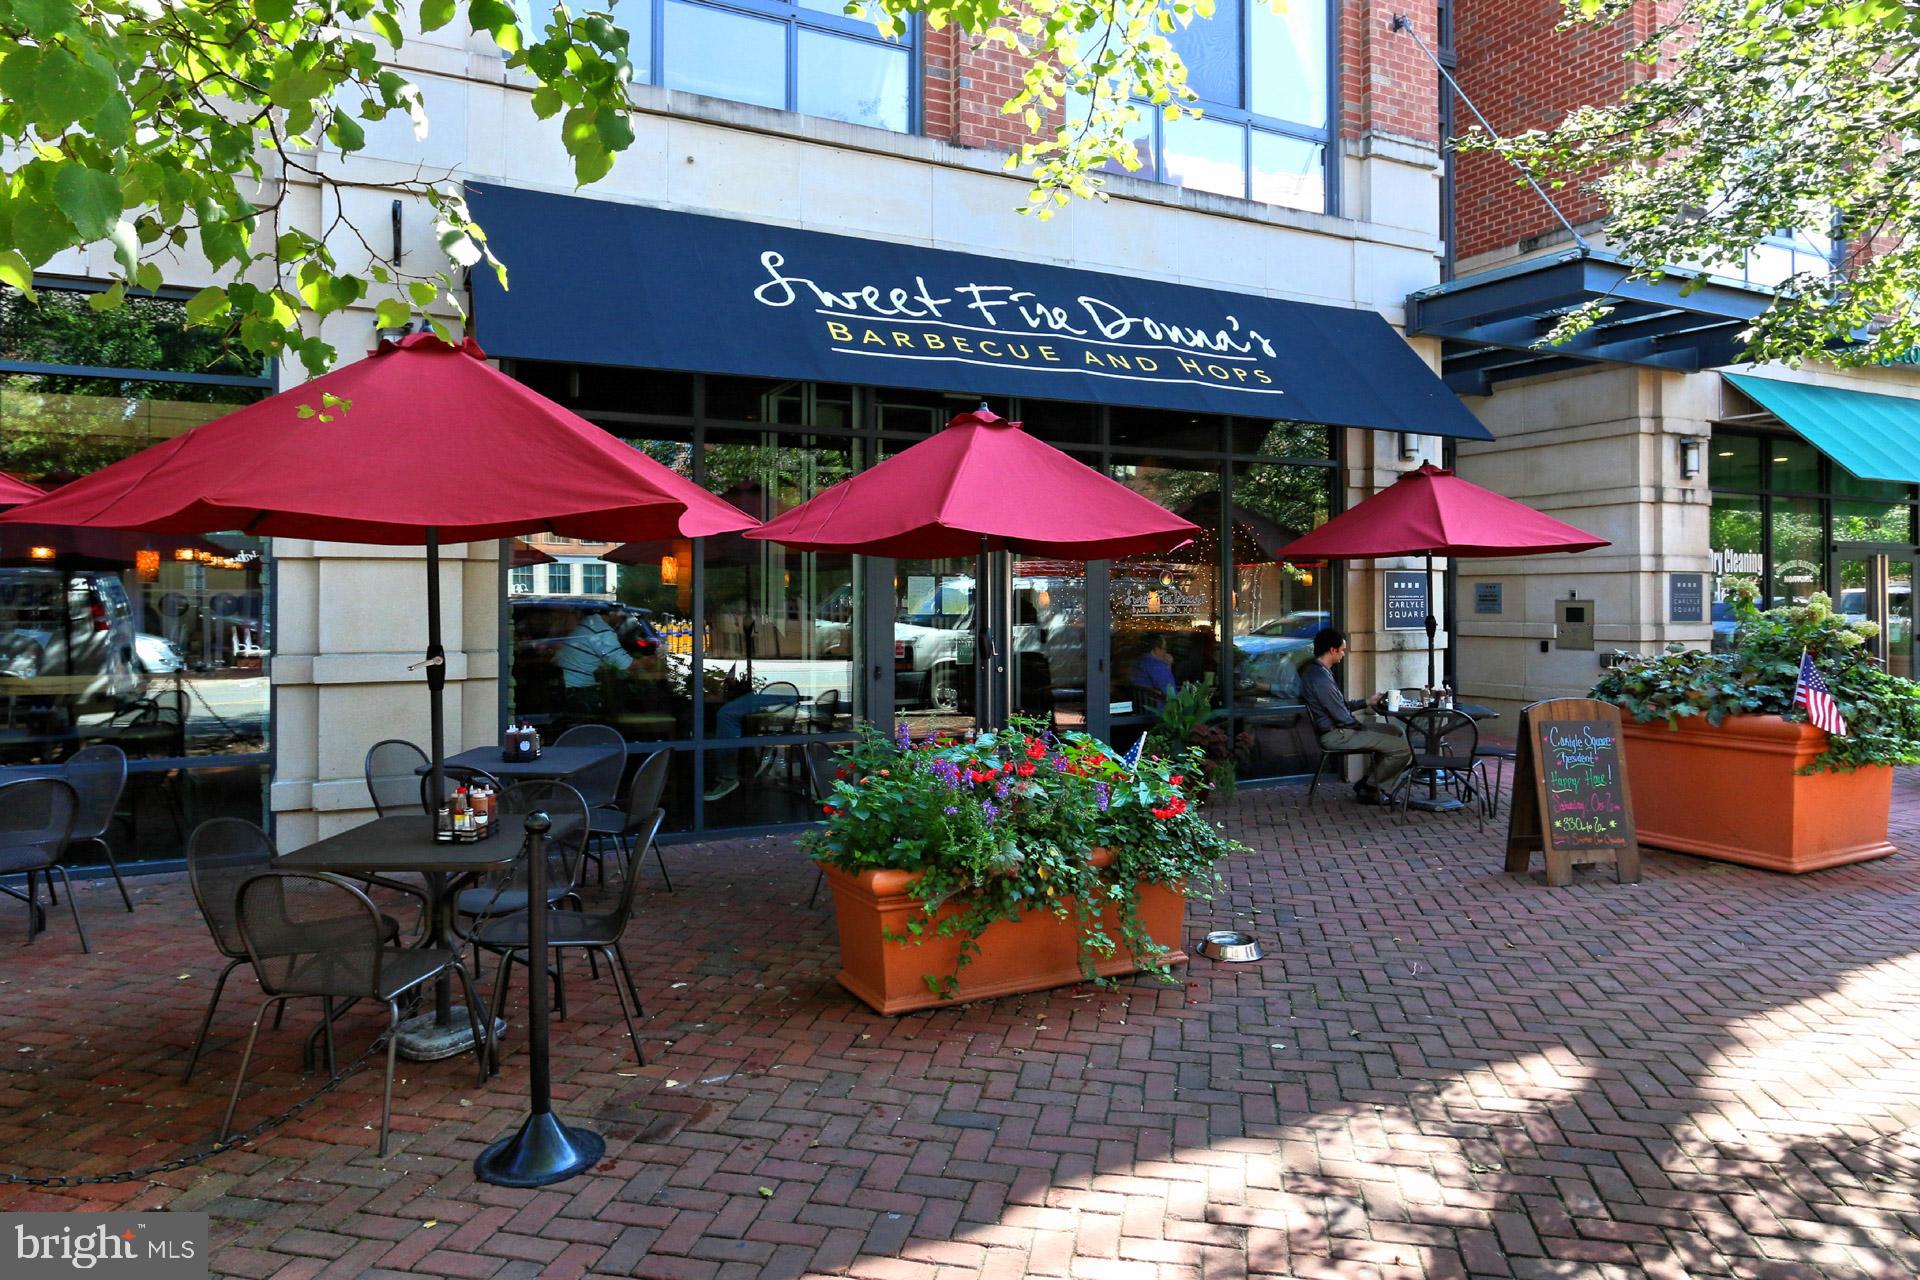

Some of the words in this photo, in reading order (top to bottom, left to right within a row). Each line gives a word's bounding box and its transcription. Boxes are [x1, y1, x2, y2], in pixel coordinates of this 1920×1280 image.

[753, 250, 952, 318] Sweet
[954, 282, 1087, 335] Fire
[1077, 295, 1277, 358] Donna's
[826, 320, 1061, 362] BARBECUE
[1085, 350, 1159, 373] AND
[1176, 355, 1273, 384] HOPS
[1724, 548, 1763, 576] Cleaning
[1389, 601, 1424, 609] CARLYLE
[1551, 770, 1580, 794] Happy
